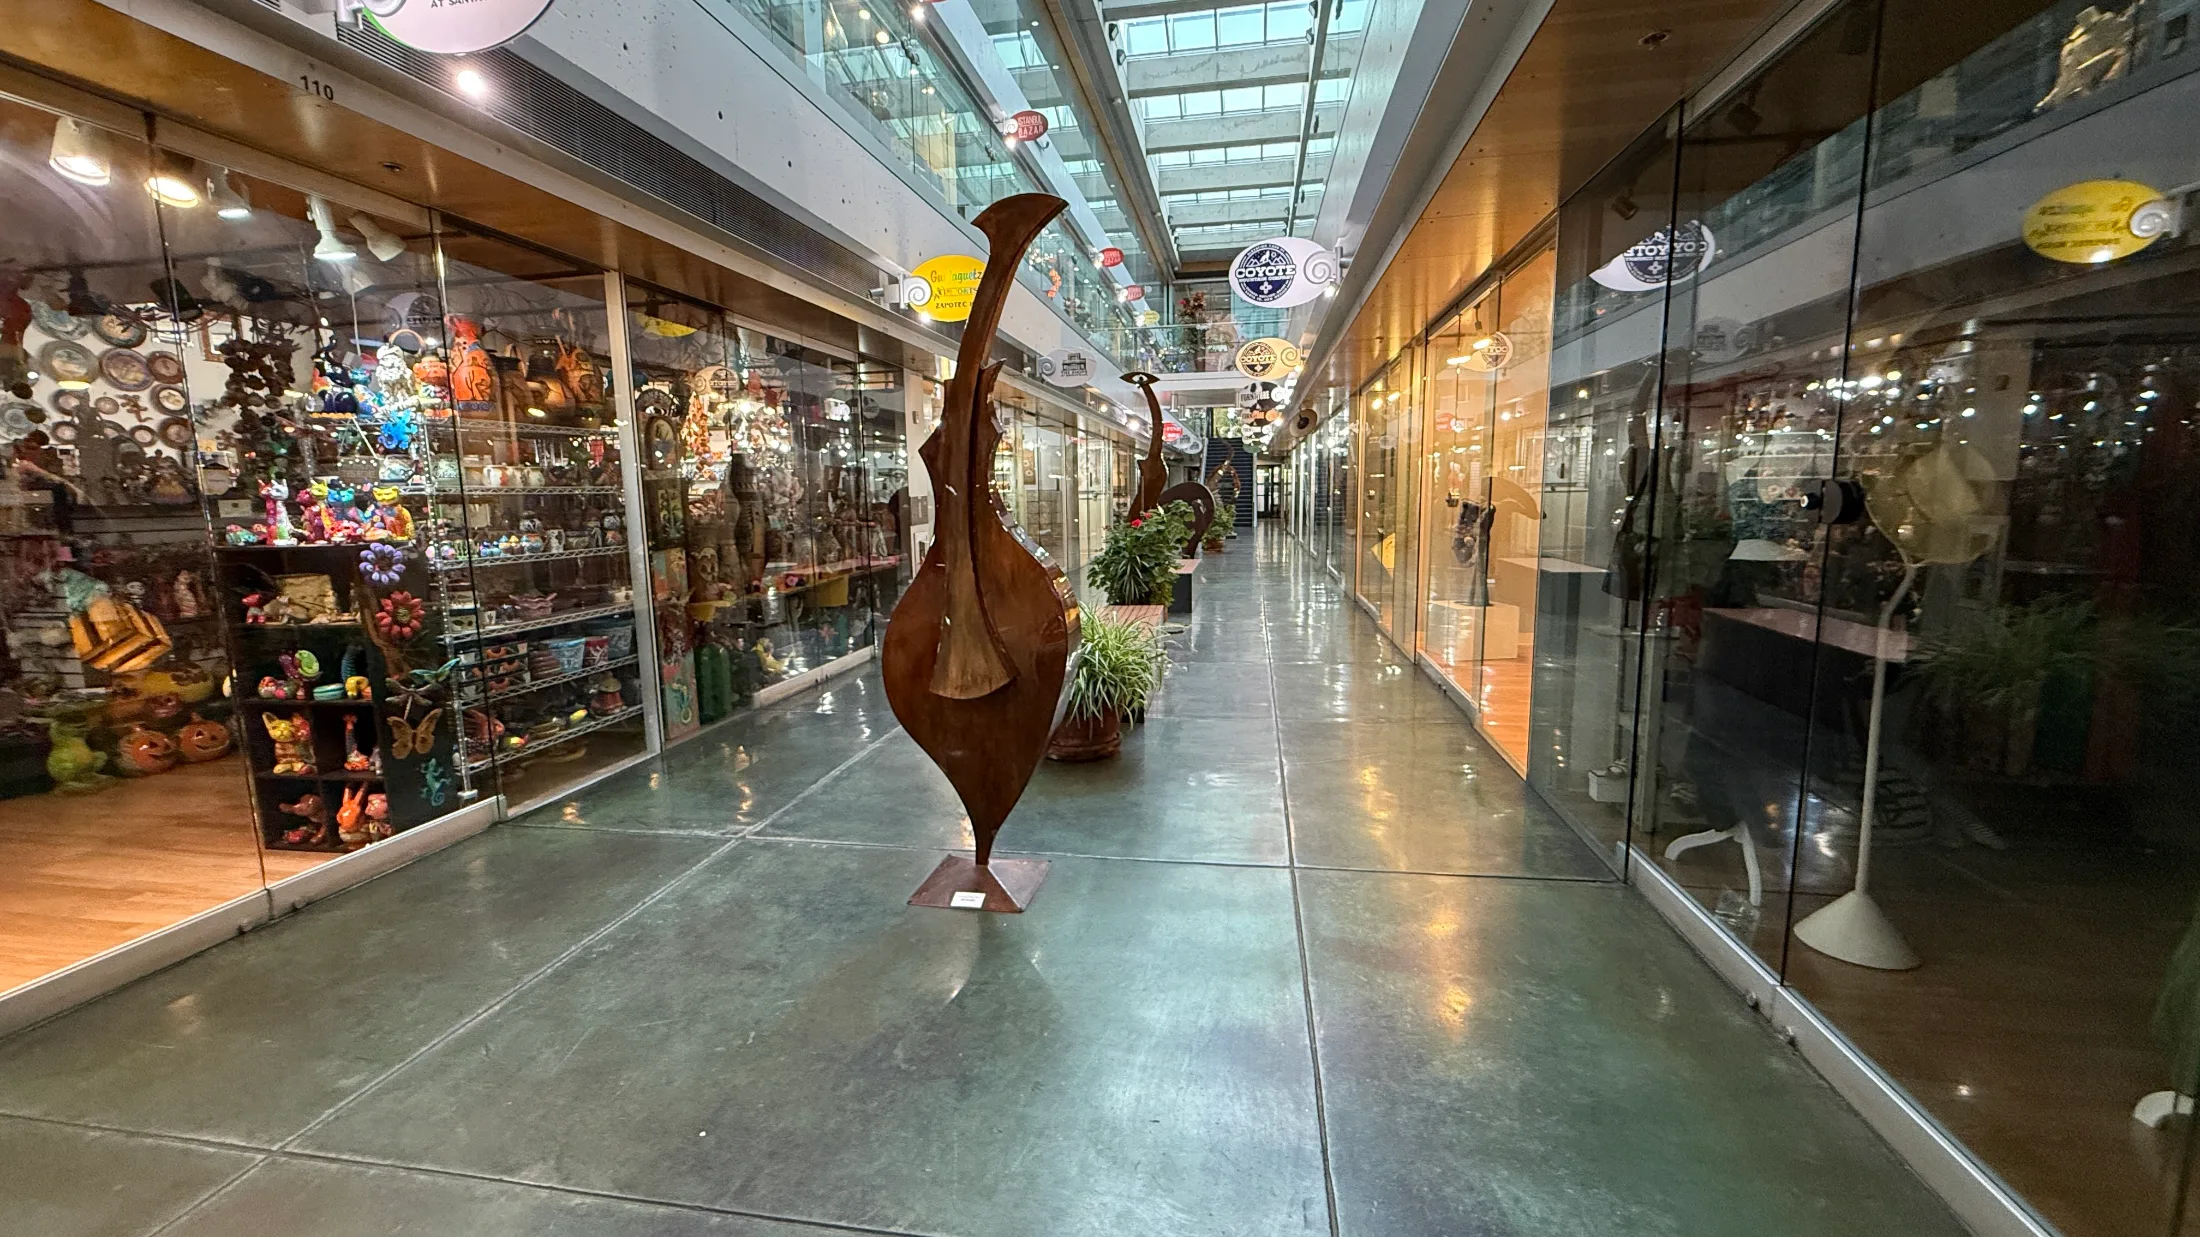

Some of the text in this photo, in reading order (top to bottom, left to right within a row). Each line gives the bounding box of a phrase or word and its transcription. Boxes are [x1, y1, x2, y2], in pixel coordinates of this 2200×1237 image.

[300, 75, 334, 101] 110
[1018, 125, 1044, 136] BAZAR
[1236, 265, 1296, 278] COYOTE
[935, 301, 968, 309] ZAPOTEC
[1240, 355, 1277, 363] COYOTE
